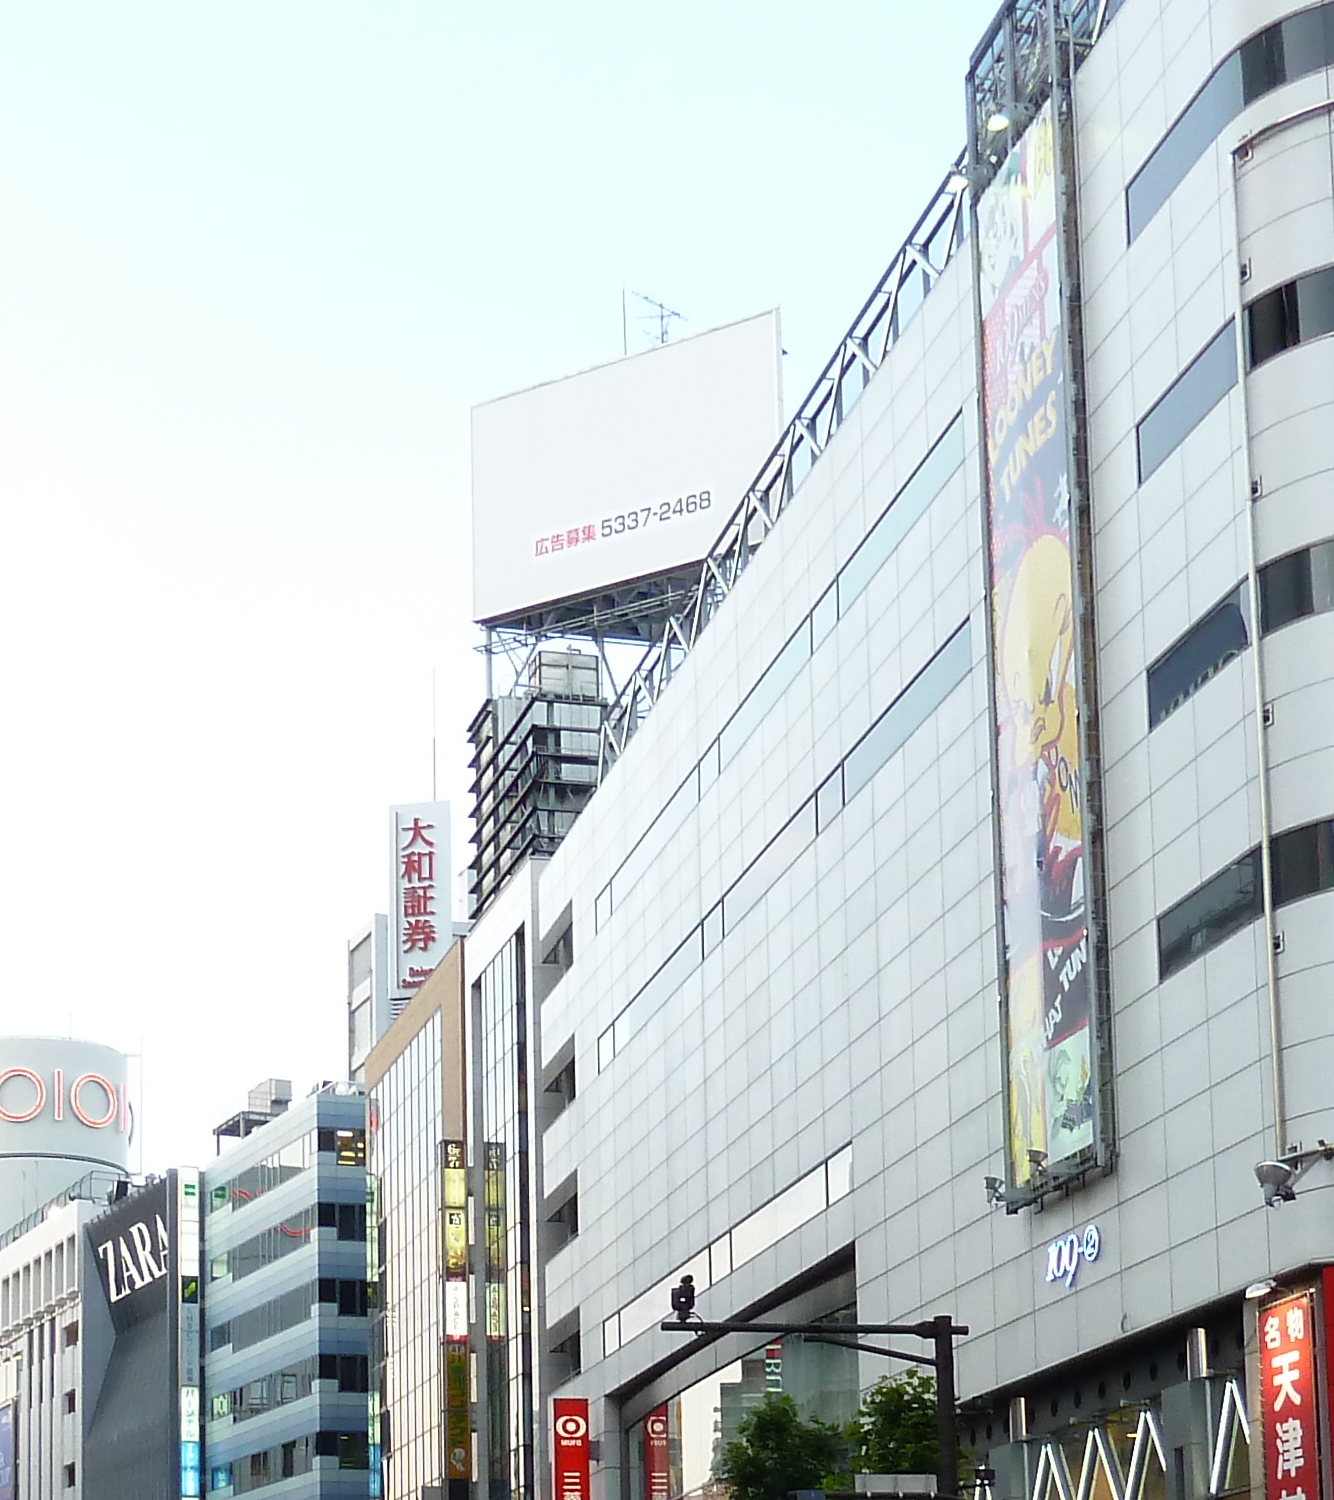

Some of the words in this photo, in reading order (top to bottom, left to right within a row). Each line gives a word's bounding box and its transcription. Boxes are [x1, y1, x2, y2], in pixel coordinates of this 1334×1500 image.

[534, 523, 597, 558] 広告募集
[601, 490, 712, 539] 5337-2468
[401, 818, 437, 956] 大和証券
[98, 1213, 169, 1304] ZARA
